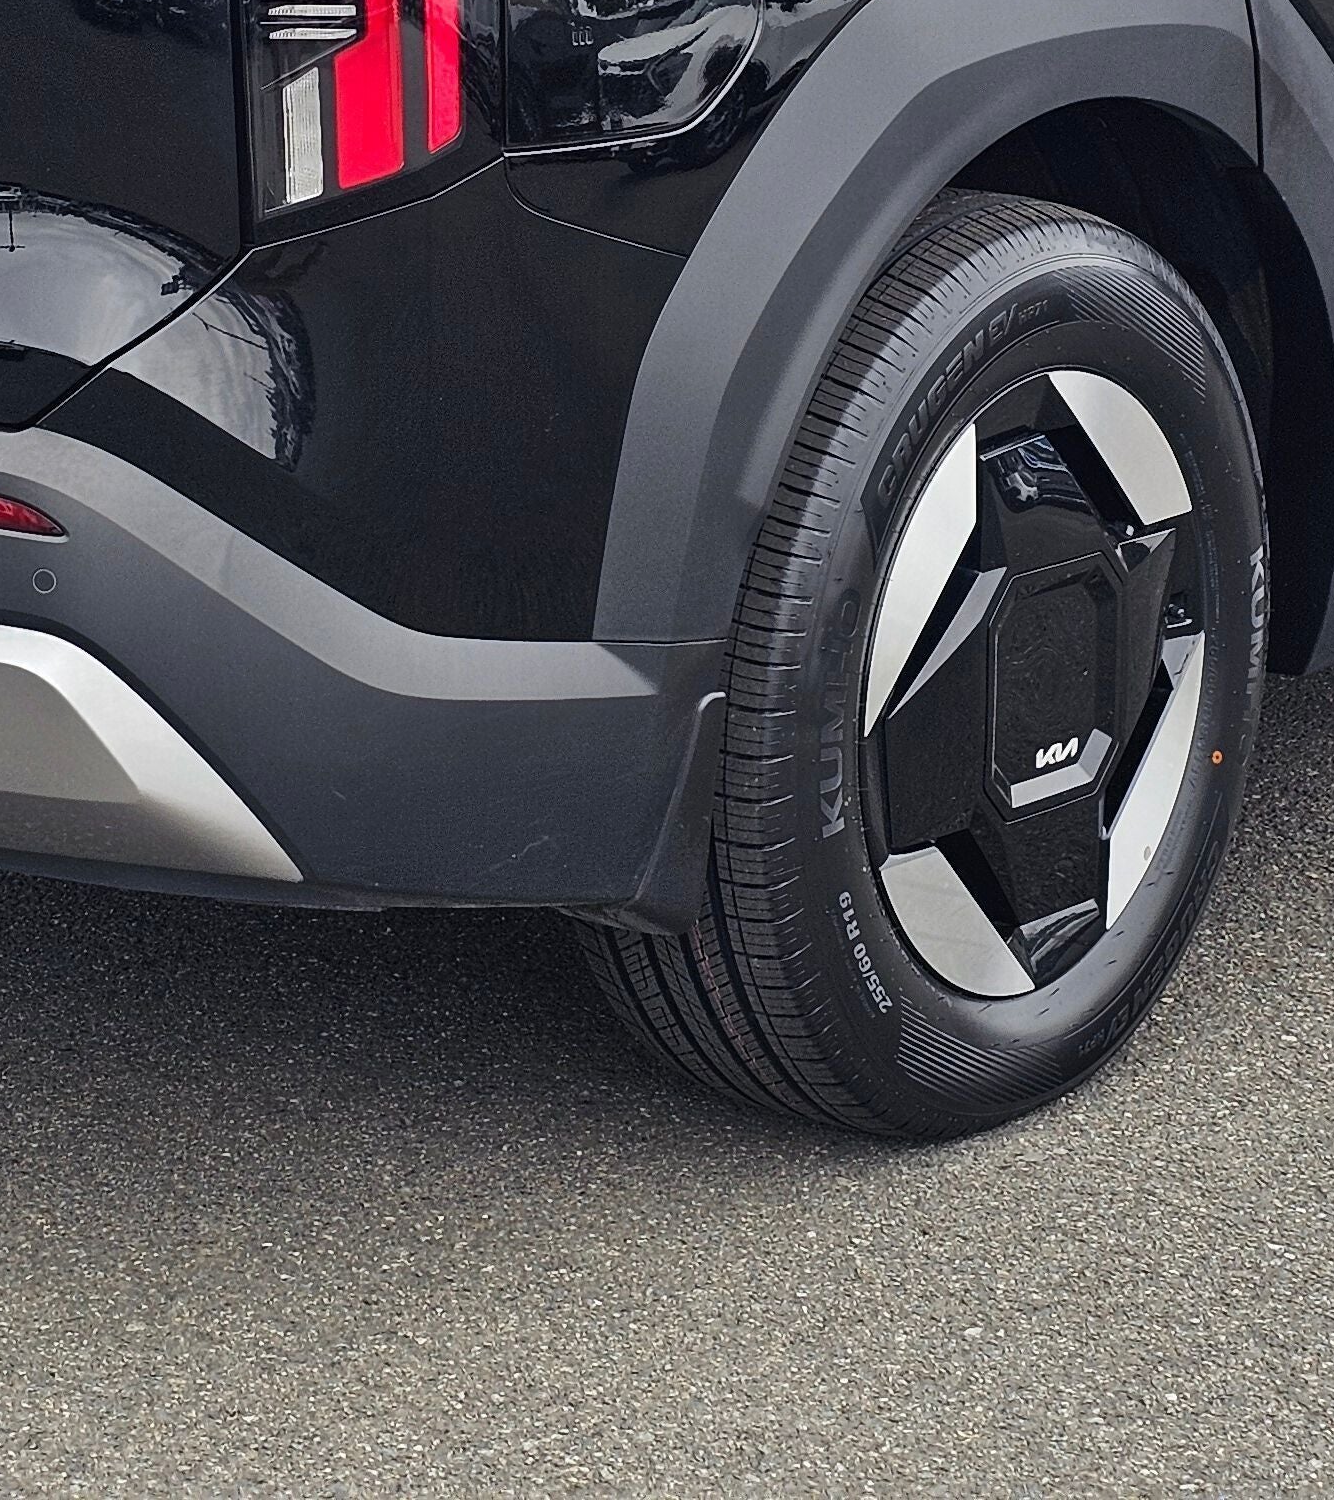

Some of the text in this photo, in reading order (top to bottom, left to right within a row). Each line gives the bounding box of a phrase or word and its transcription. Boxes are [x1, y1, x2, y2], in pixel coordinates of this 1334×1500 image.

[1035, 736, 1079, 770] KIA
[838, 891, 861, 941] R19
[853, 942, 893, 1014] 255/60
